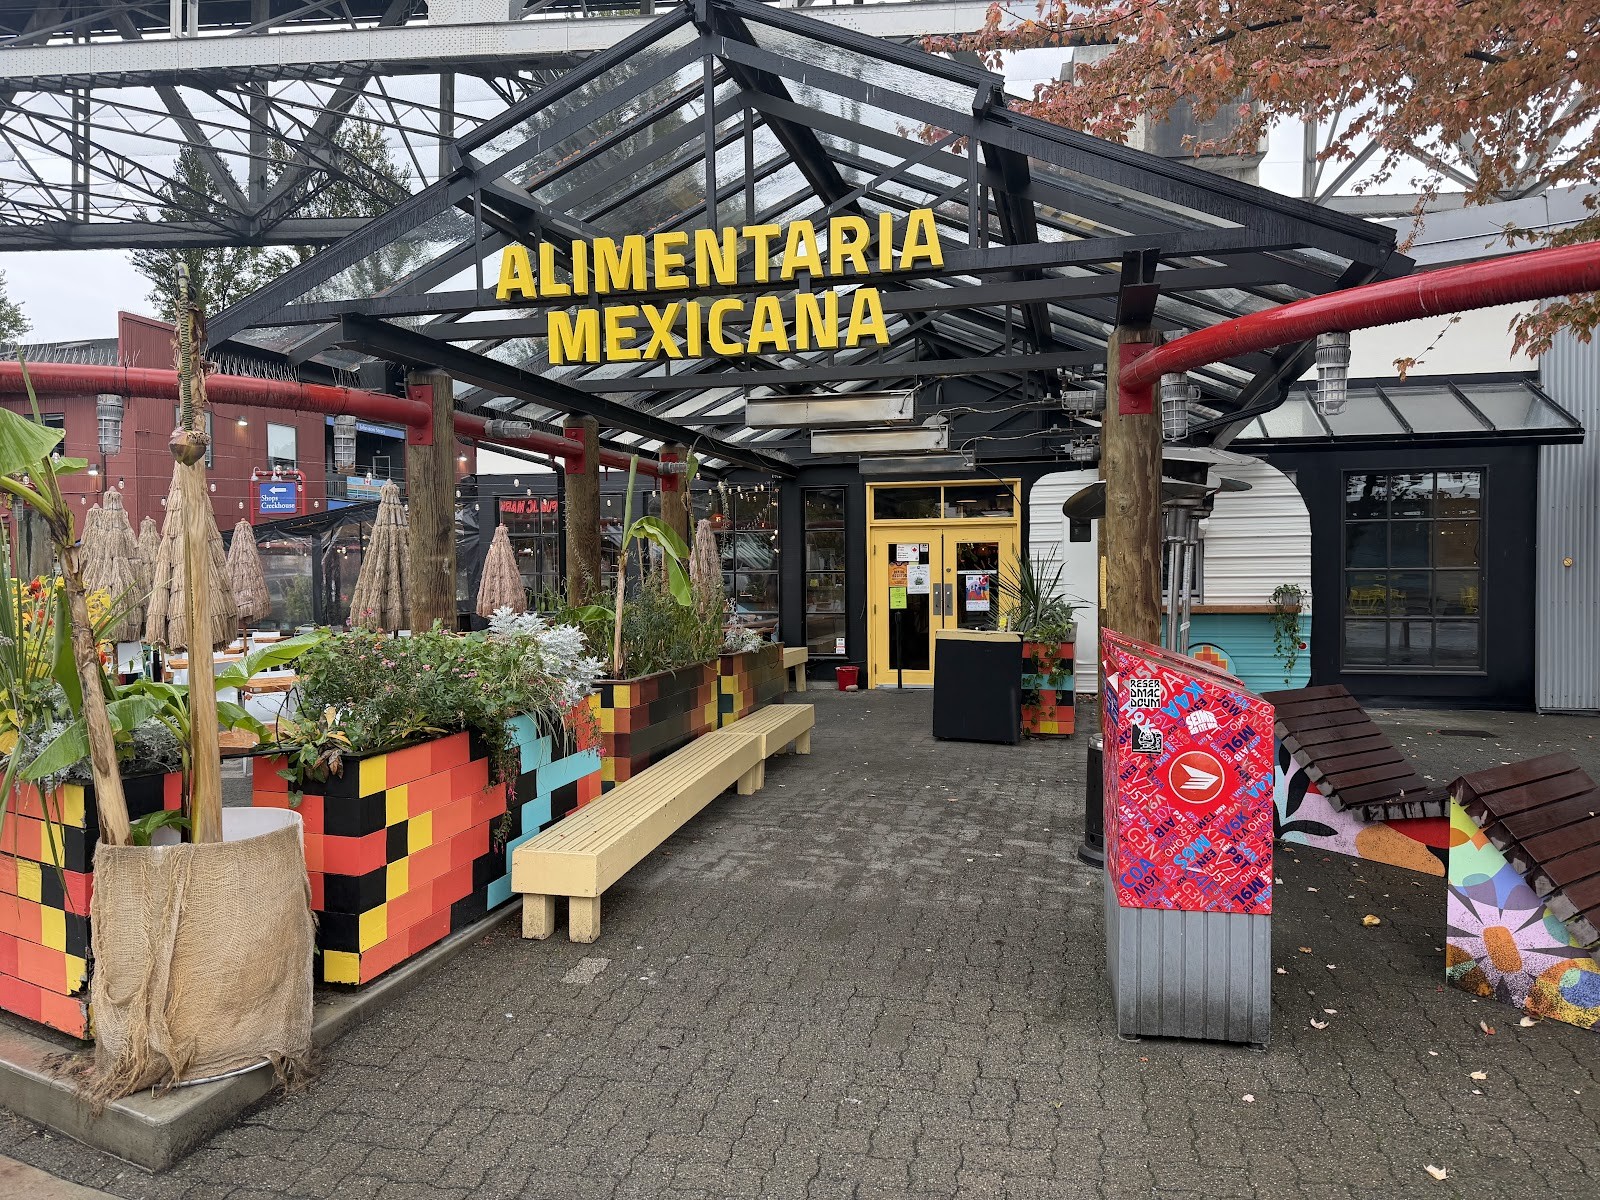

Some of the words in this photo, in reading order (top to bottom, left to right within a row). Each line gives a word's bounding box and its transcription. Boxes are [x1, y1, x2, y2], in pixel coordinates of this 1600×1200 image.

[495, 207, 944, 301] ALIMENTARIA
[547, 287, 890, 365] MEXICANA
[261, 495, 278, 503] Shops
[1130, 679, 1160, 688] RESER
[1160, 680, 1205, 719] K4A
[1221, 724, 1256, 753] M9L
[1219, 810, 1251, 837] V6K
[1231, 876, 1266, 906] M9L
